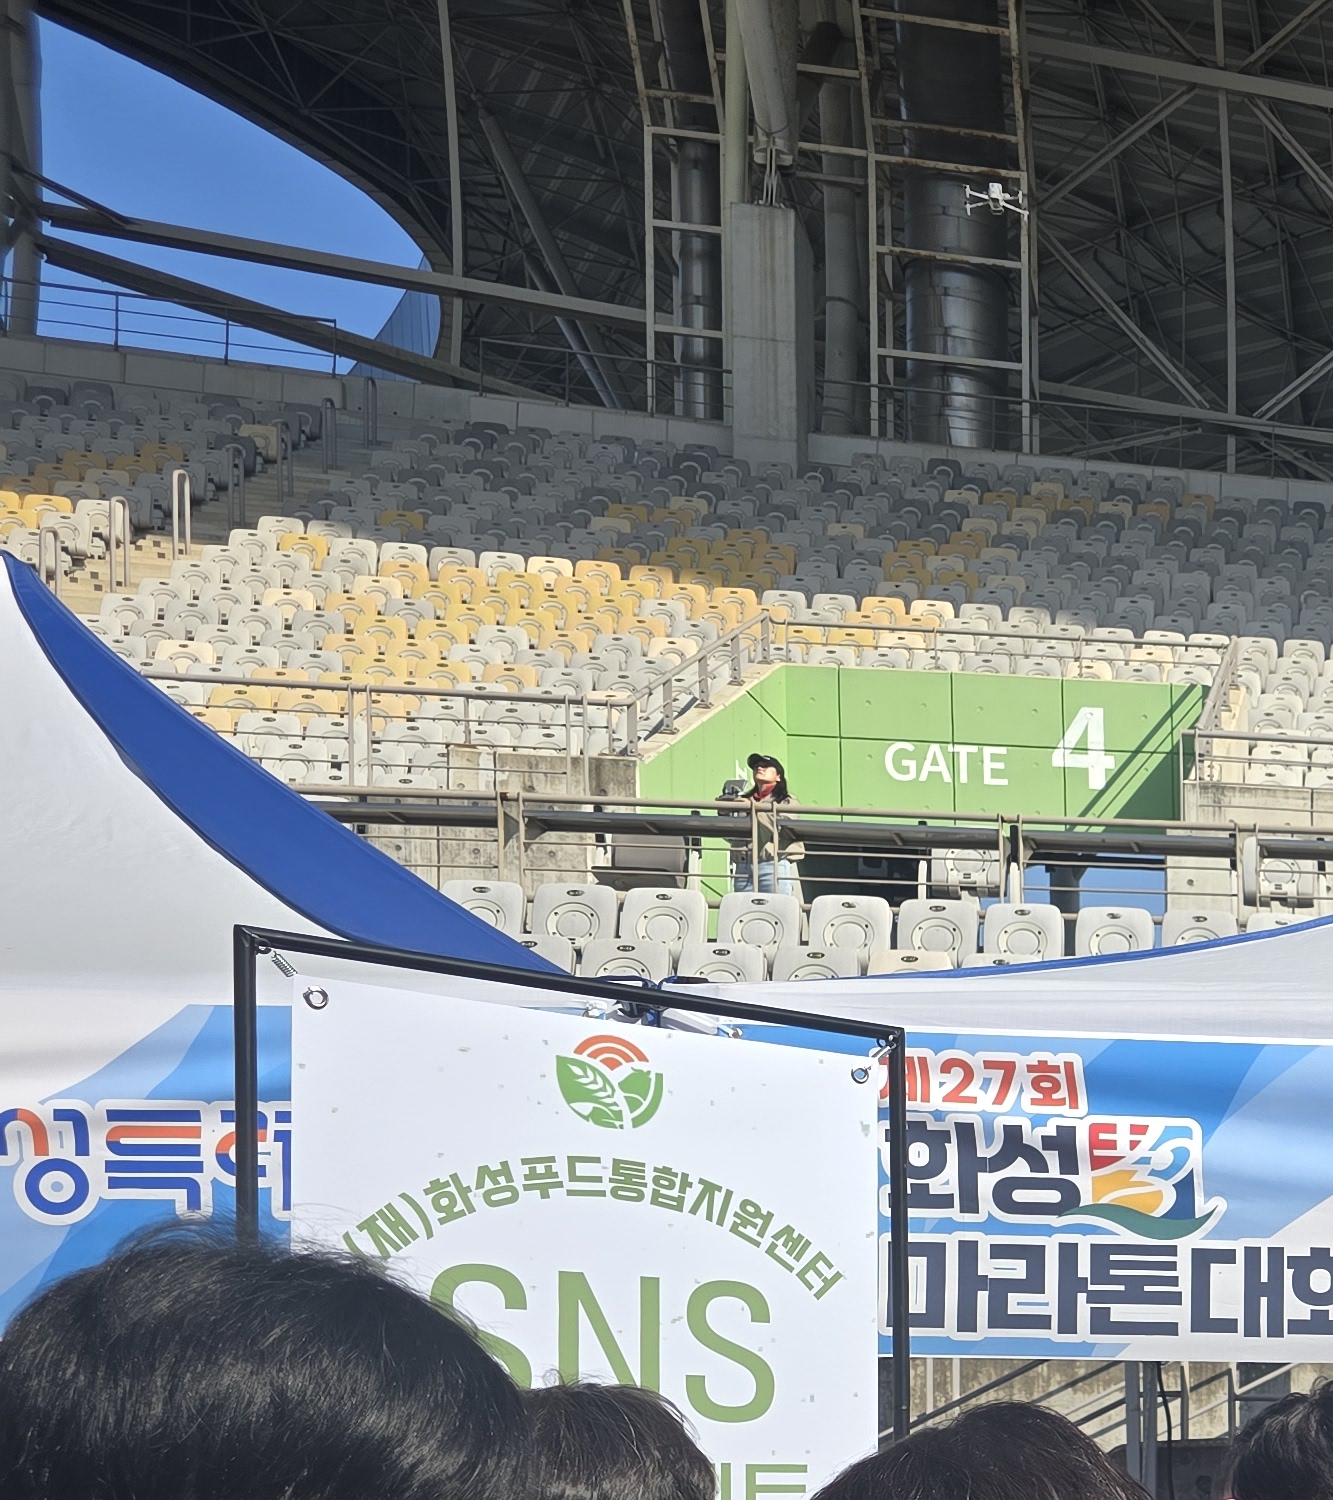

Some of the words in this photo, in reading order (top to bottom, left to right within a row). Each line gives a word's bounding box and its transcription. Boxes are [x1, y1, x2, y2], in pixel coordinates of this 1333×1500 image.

[884, 741, 1009, 786] GATE
[1051, 706, 1116, 791] 4
[879, 1056, 1080, 1110] 제27회
[884, 1120, 1082, 1217] 화성
[430, 1263, 776, 1424] SNS
